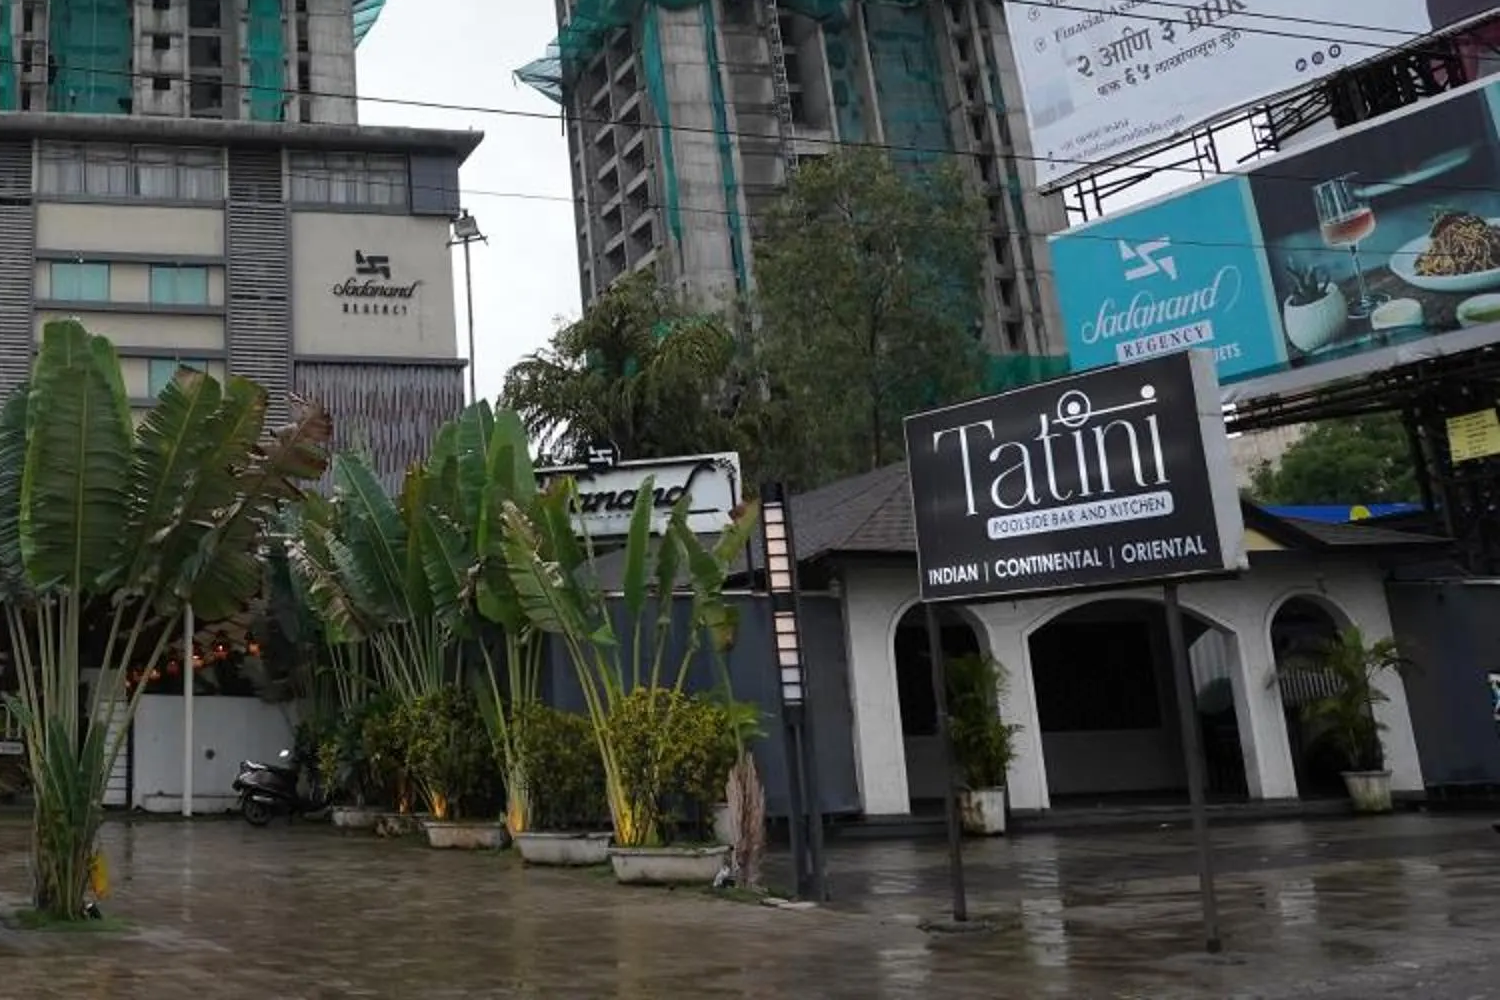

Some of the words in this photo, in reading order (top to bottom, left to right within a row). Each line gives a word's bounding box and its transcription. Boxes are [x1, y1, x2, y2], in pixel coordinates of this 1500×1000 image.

[1077, 54, 1093, 77] २
[1099, 25, 1152, 67] आणि
[1124, 62, 1151, 86] ६५
[331, 277, 426, 299] Sadanand
[1081, 264, 1243, 345] Sadanand
[1122, 324, 1206, 359] REGENCY
[933, 384, 1171, 517] Tatini
[992, 512, 1051, 535] POOLSIDE
[1051, 508, 1077, 527] BAR
[1079, 504, 1107, 523] AND
[1109, 496, 1168, 519] KITCHEN
[928, 563, 979, 585] INDIAN
[994, 548, 1103, 578] CONTINENTAL
[1120, 534, 1207, 564] ORIENTAL
